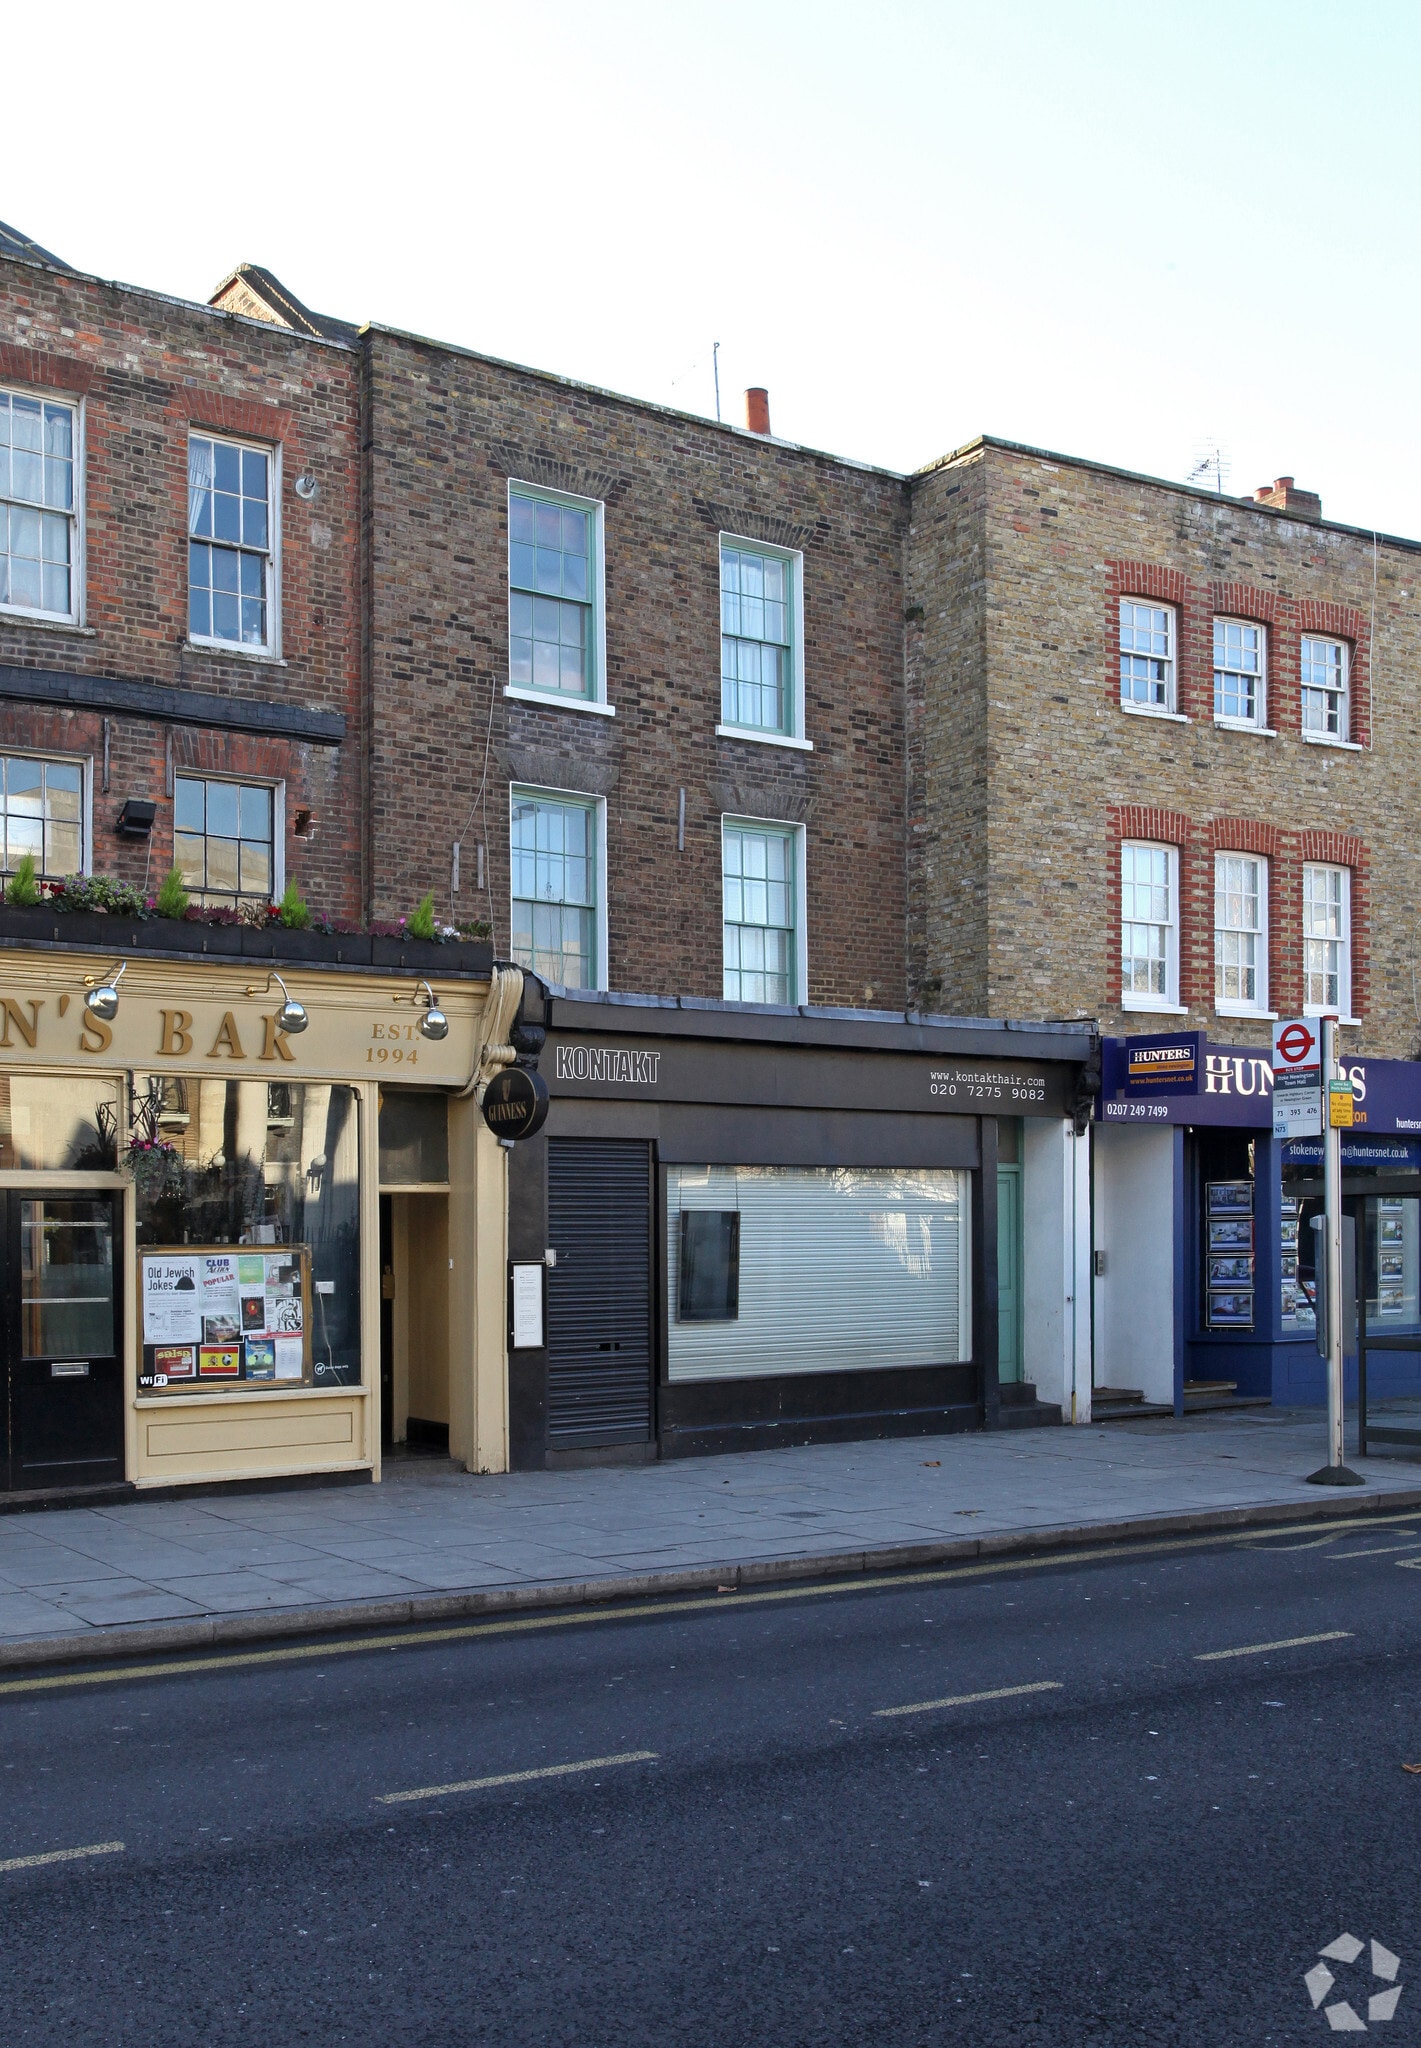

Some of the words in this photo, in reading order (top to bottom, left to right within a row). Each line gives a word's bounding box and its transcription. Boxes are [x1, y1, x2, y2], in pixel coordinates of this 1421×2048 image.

[157, 1009, 297, 1061] BAR
[371, 1023, 420, 1041] EST.
[366, 1047, 418, 1065] 1994
[1134, 1048, 1191, 1062] HUNTERS
[557, 1046, 660, 1083] KONTAKT
[930, 1071, 1046, 1087] www.kontakthair.com
[1130, 1075, 1193, 1085] www.huntersnet.co.uk
[1205, 1055, 1366, 1102] HUNS
[930, 1083, 957, 1096] 020
[967, 1085, 1002, 1098] 7275
[1011, 1088, 1045, 1101] 9082
[488, 1101, 527, 1121] GUINNESS
[1107, 1103, 1127, 1116] 0207
[1130, 1104, 1145, 1117] 249
[1147, 1105, 1168, 1117] 7499
[1275, 1126, 1286, 1134] N73
[206, 1258, 230, 1267] CLUB
[147, 1266, 162, 1279] Old
[164, 1266, 195, 1279] Jewish
[147, 1279, 174, 1291] Jokes
[203, 1273, 235, 1287] POPULAR
[157, 1349, 192, 1359] salsa
